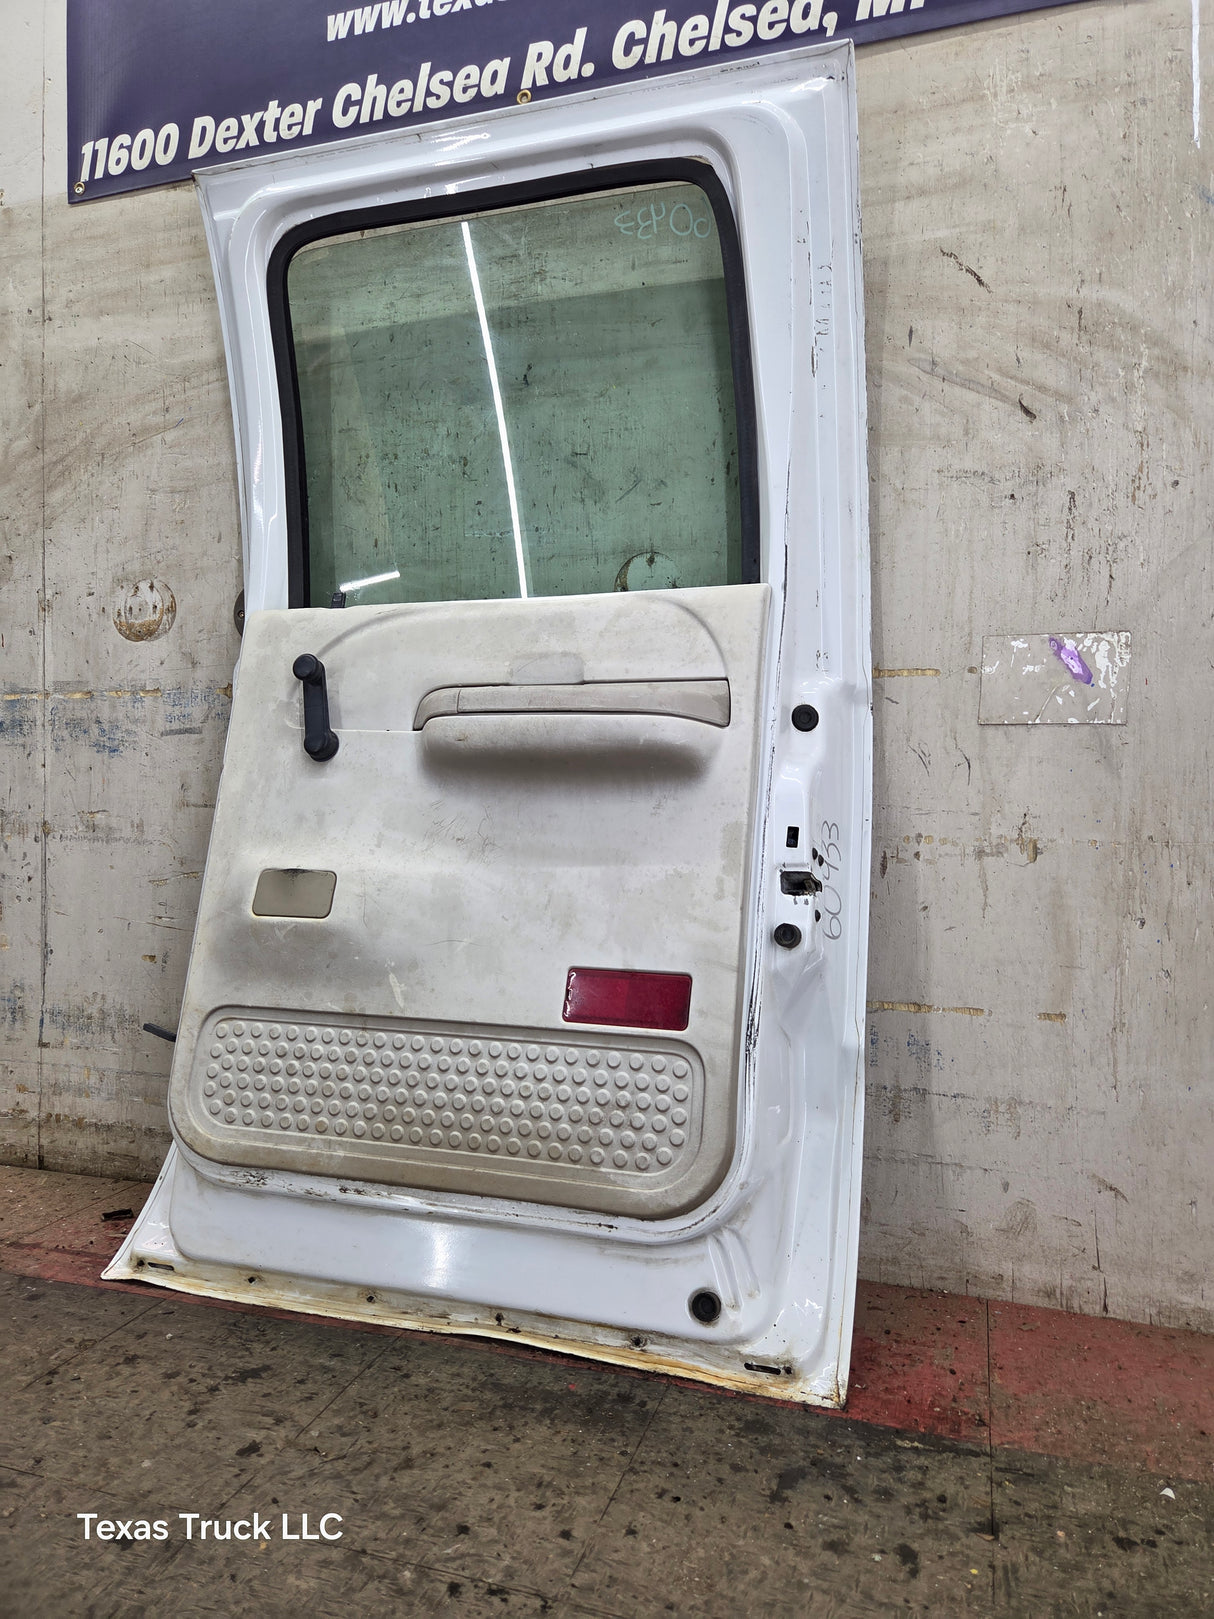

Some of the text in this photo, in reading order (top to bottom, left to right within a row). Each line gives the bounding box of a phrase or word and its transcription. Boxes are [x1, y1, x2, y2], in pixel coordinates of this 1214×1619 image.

[80, 0, 838, 182] 11600 Dexter Chelsea Rd. Chelsea,
